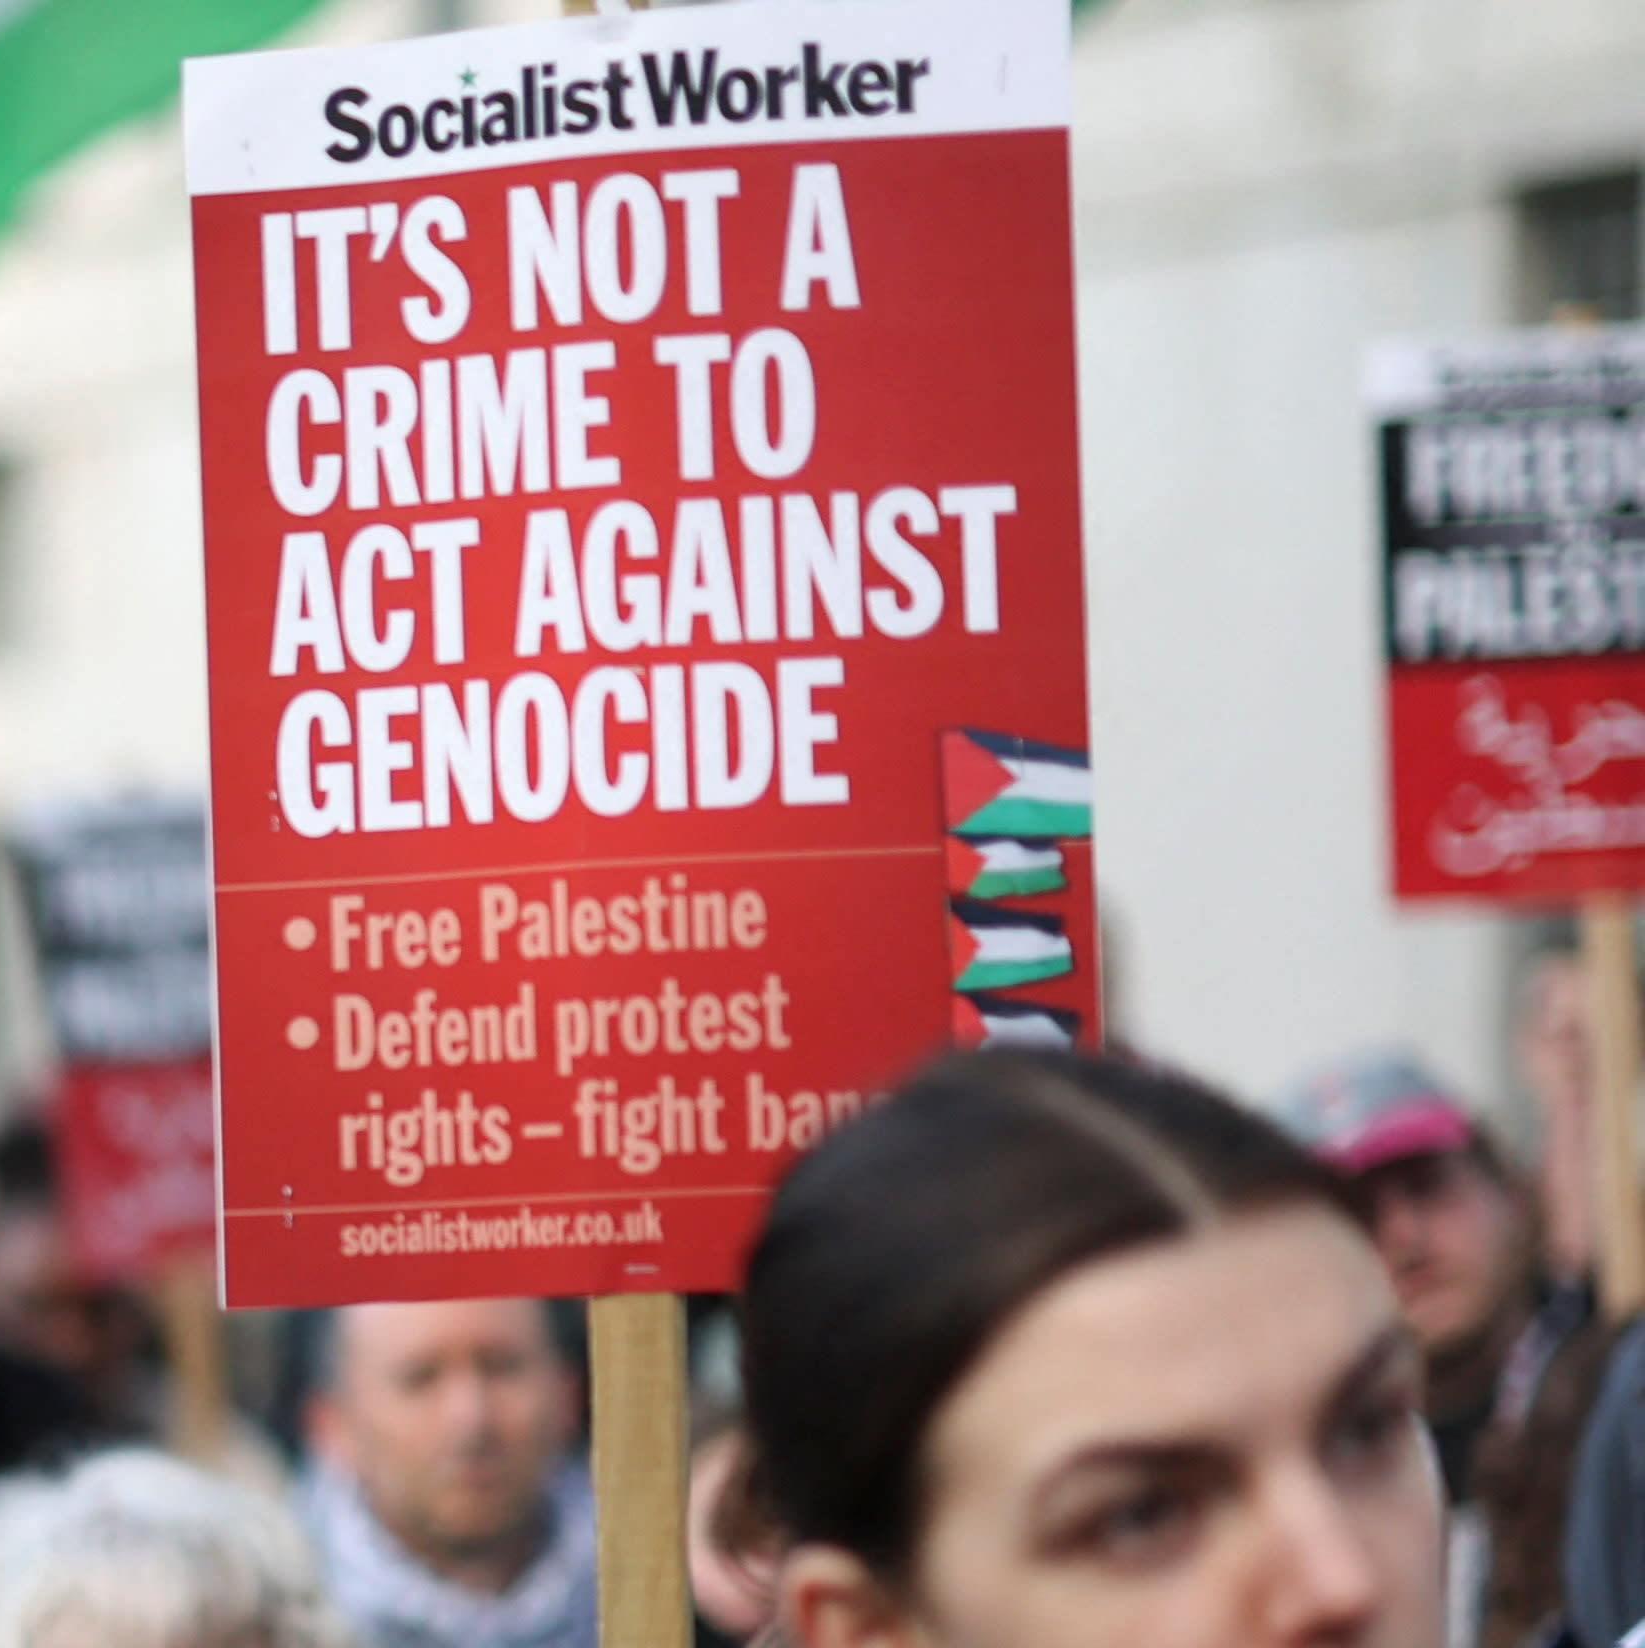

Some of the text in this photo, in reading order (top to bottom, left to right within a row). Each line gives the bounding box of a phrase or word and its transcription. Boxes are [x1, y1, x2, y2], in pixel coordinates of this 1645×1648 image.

[323, 43, 930, 163] Socialist Worker
[261, 162, 862, 355] IT'S NOT A
[265, 327, 817, 516] CRIME TO
[268, 483, 1018, 677] ACT AGAINST
[275, 656, 851, 839] GENOCIDE
[328, 873, 768, 972] Free Palestine
[331, 974, 791, 1075] Defend protest
[745, 1071, 895, 1152] ban
[339, 1201, 664, 1258] socialistworker.co.uk
